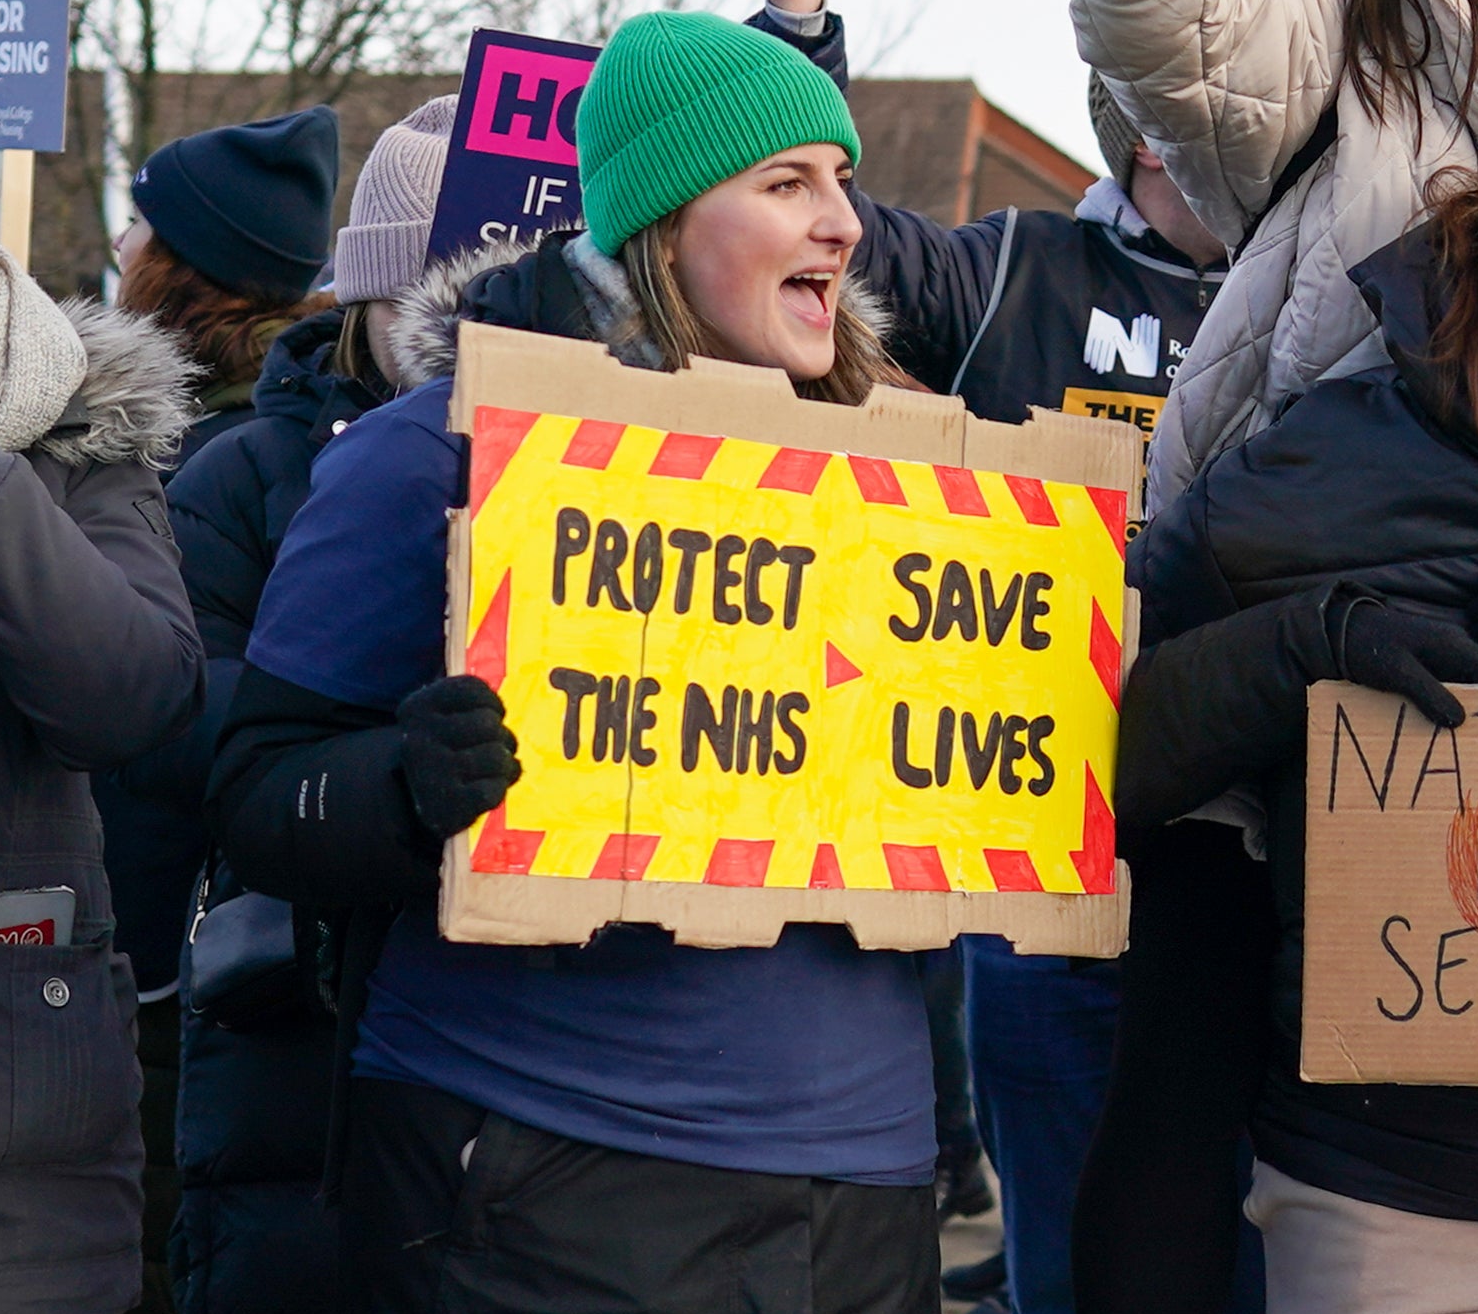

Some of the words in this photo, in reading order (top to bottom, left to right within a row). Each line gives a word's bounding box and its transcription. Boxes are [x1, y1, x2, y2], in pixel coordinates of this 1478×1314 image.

[523, 175, 567, 216] IF
[1085, 402, 1156, 432] THE
[553, 507, 815, 631] PROTECT
[889, 553, 1054, 651] SAVE
[549, 667, 662, 767] THE
[681, 683, 811, 776] NHS
[891, 702, 1055, 797] LIVES
